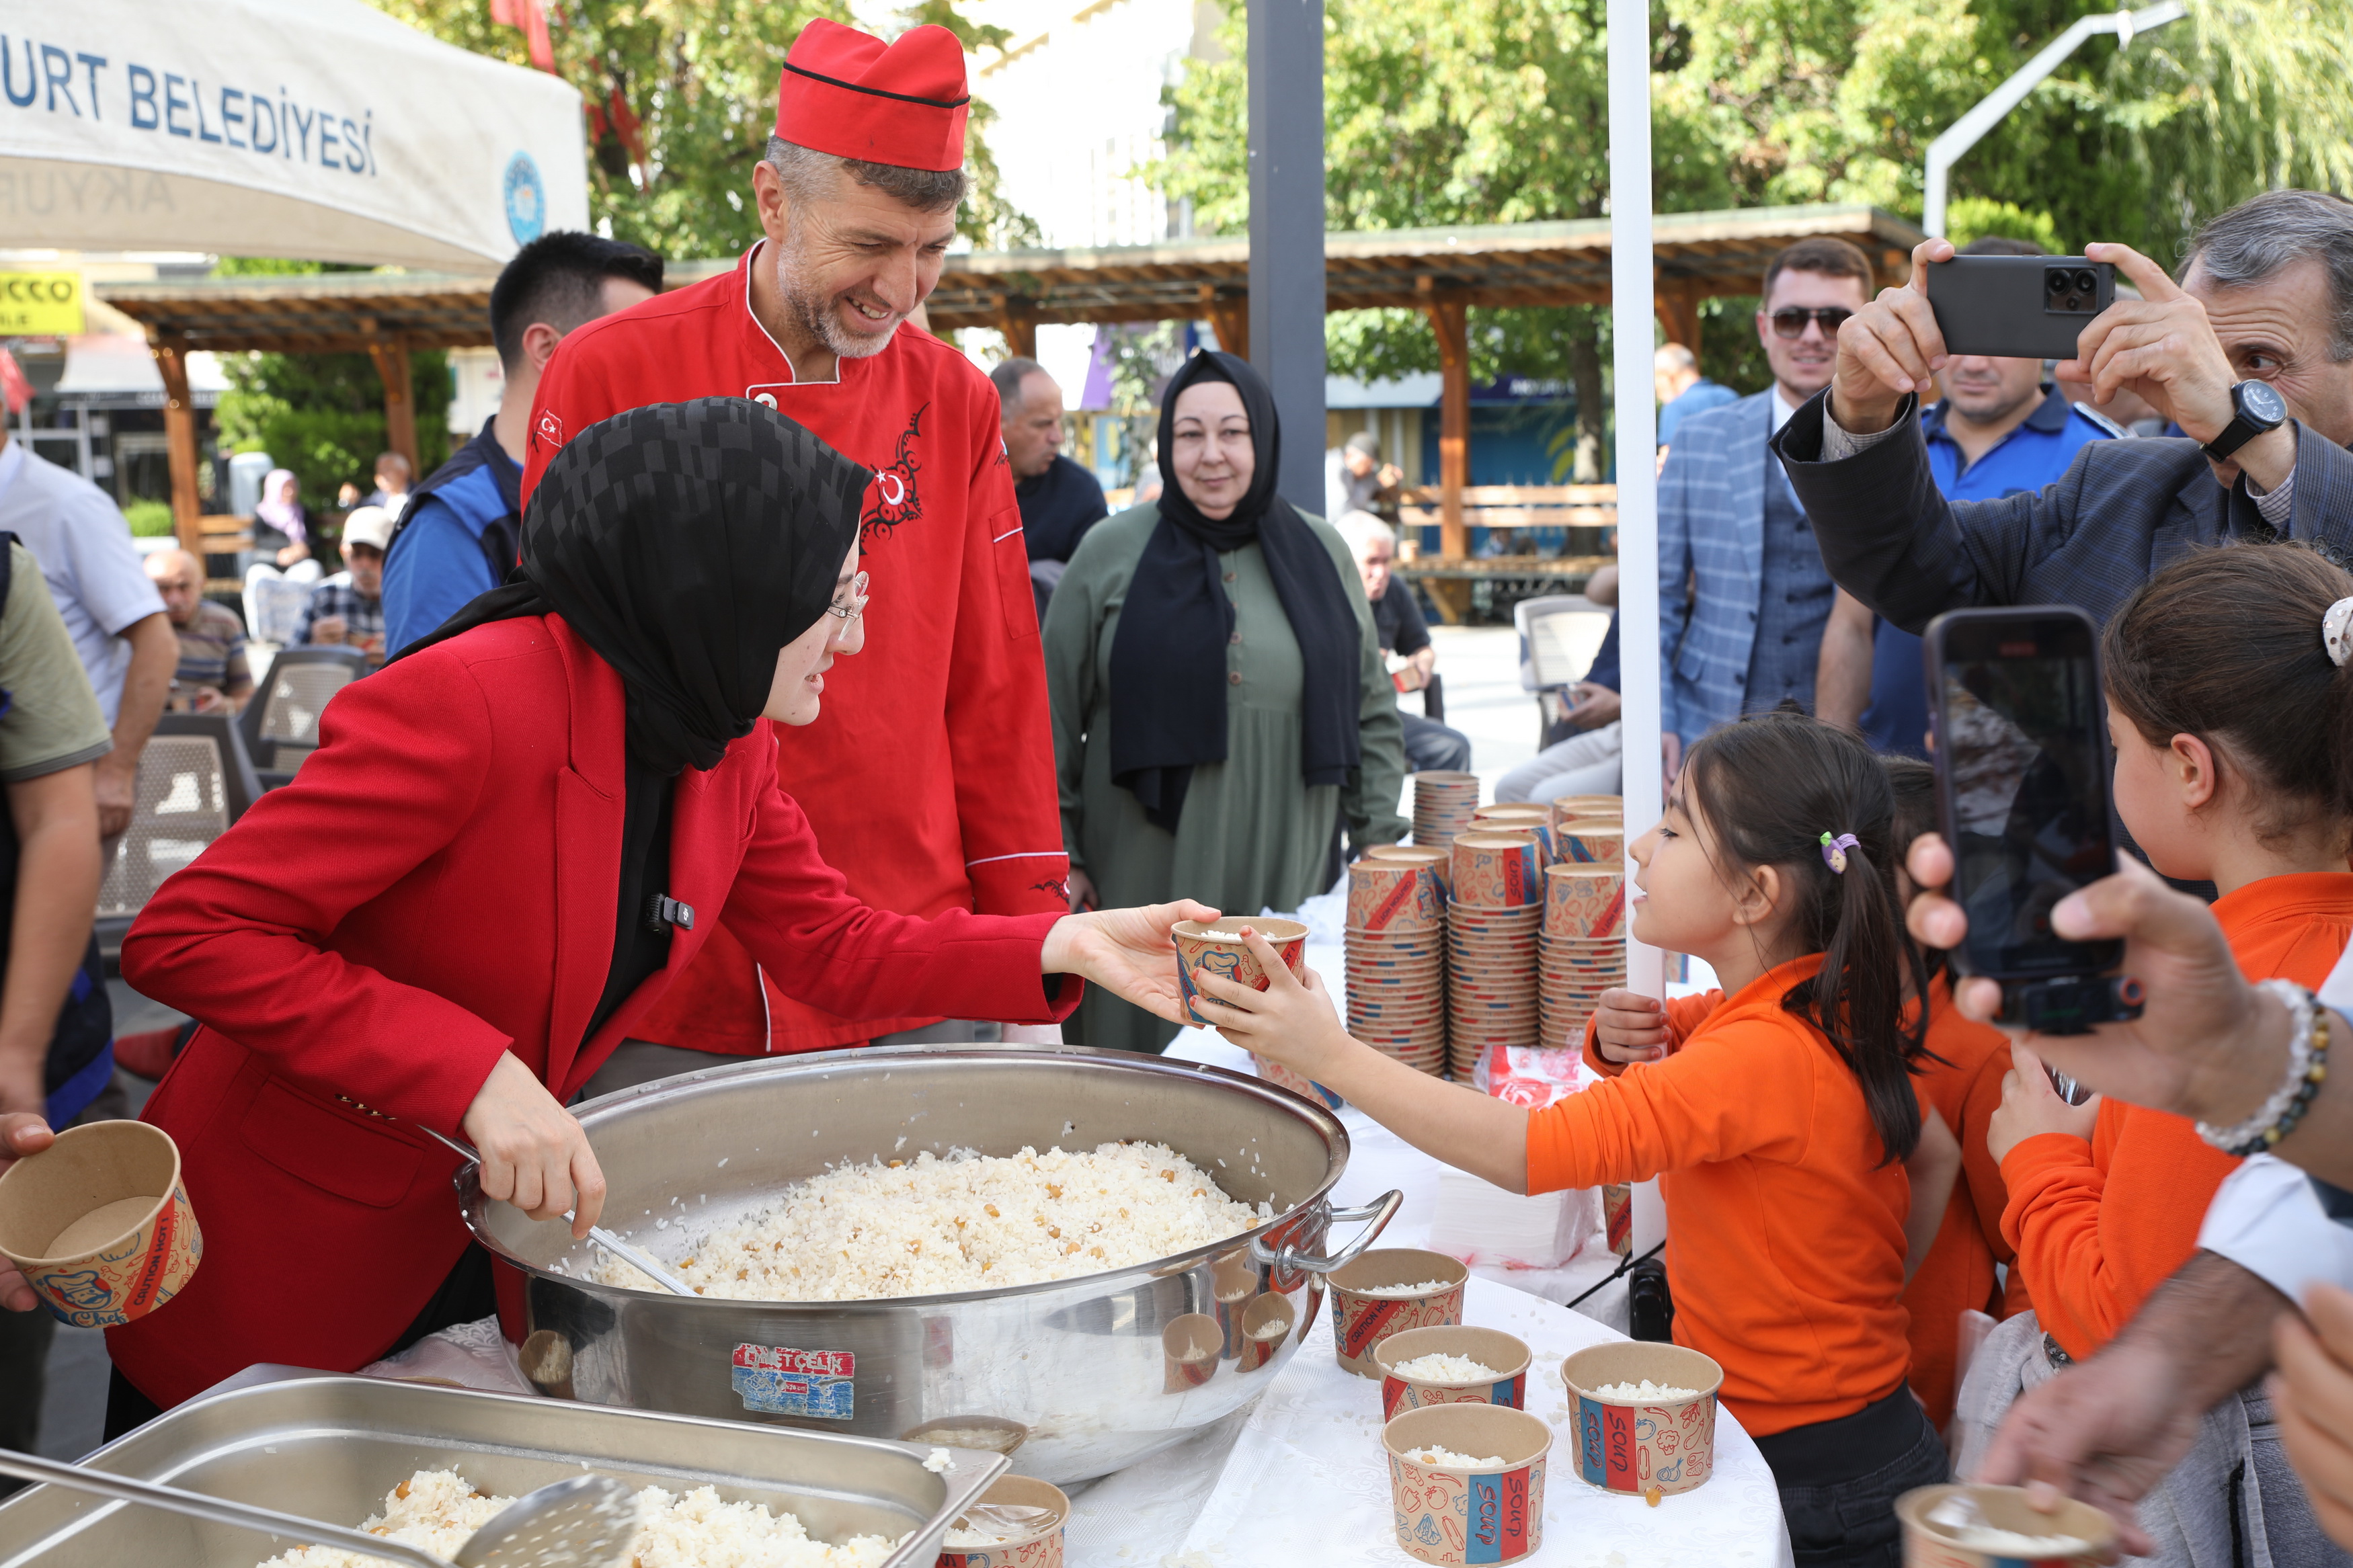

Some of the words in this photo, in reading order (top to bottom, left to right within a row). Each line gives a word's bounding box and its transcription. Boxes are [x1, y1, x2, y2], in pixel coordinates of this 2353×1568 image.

[128, 63, 378, 177] BELEDİYESİ
[0, 280, 72, 303] CCO
[1390, 880, 1412, 909] CAUTION
[1509, 860, 1522, 899] SOUP
[133, 1255, 161, 1306] CAUTION
[155, 1226, 168, 1253] HOT
[71, 1307, 128, 1329] Chef
[1351, 1311, 1378, 1344] CAUTION
[1375, 1300, 1389, 1313] HO
[1583, 1404, 1603, 1469] SOUP
[1608, 1411, 1628, 1472] SOUP
[1476, 1481, 1497, 1546] SOUP
[1506, 1476, 1523, 1538] SOUP
